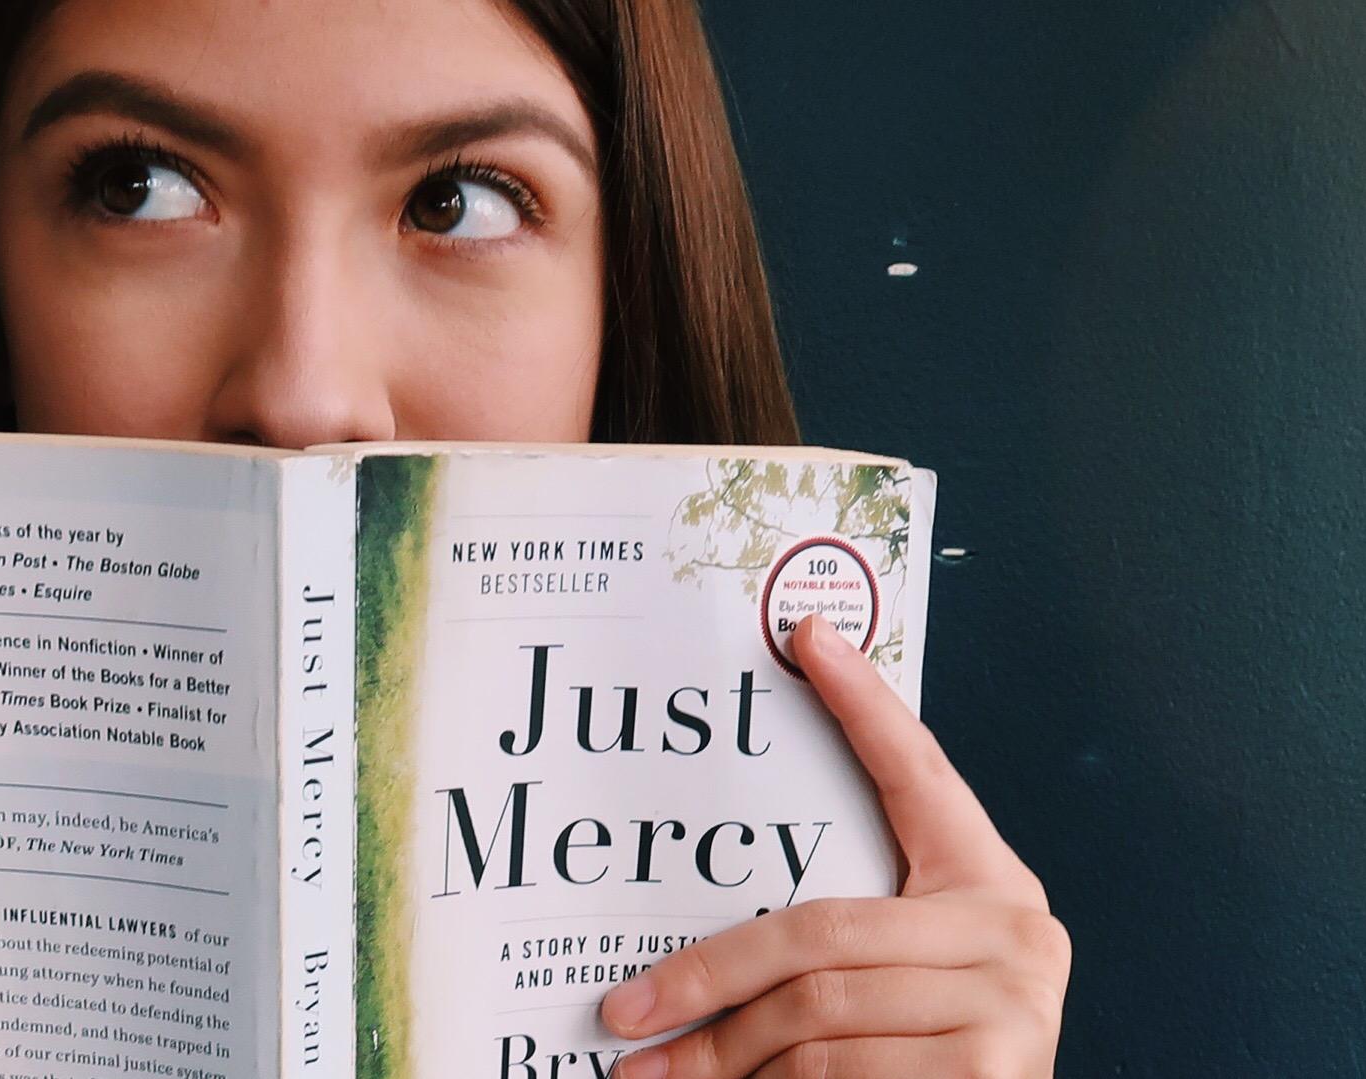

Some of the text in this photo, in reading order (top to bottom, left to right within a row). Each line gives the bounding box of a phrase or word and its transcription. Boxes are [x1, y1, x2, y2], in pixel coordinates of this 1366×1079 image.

[16, 523, 32, 539] of
[37, 524, 63, 541] the
[68, 529, 101, 545] year
[106, 528, 124, 547] by
[12, 551, 48, 569] Post
[66, 554, 95, 572] The
[99, 557, 153, 577] Boston
[157, 561, 200, 580] Globe
[452, 539, 645, 564] NEW YORK TIMES
[808, 559, 838, 575] 100
[33, 583, 93, 603] Esquire
[480, 573, 610, 596] BESTSELLER
[783, 581, 861, 590] NOTABLE BOOKS
[778, 617, 863, 632] Bo view
[37, 634, 52, 651] in
[57, 636, 137, 657] Nonfiction
[152, 643, 205, 664] Winner
[208, 650, 224, 666] of
[51, 664, 67, 681] of
[71, 666, 96, 683] the
[100, 668, 145, 687] Books
[148, 673, 169, 689] for
[172, 679, 182, 691] a
[186, 676, 231, 695] Better
[0, 689, 46, 708] Times
[49, 693, 88, 711] Book
[93, 696, 131, 715] Prize
[147, 701, 202, 723] Finalist
[206, 707, 227, 725] for
[498, 644, 772, 757] Just
[12, 720, 101, 741] Association
[106, 726, 165, 747] Notable
[169, 732, 206, 751] Book
[290, 583, 336, 892] Just Mercy
[11, 811, 51, 829] may,
[54, 810, 116, 833] indeed,
[119, 816, 139, 834] be
[26, 837, 57, 852] The
[59, 839, 96, 856] New
[99, 843, 135, 860] York
[138, 847, 184, 866] Times
[431, 780, 833, 918] Mercy
[3, 907, 103, 930] INFLUENTIAL
[108, 916, 177, 940] LAWYERS
[184, 929, 201, 943] of
[202, 933, 230, 946] our
[35, 937, 62, 954] the
[64, 942, 146, 967] redeeming
[147, 953, 214, 974] potential
[214, 961, 231, 975] of
[501, 934, 709, 962] A STORY OF JUST
[32, 967, 100, 987] attorney
[102, 973, 145, 991] when
[147, 977, 166, 993] he
[169, 980, 230, 1003] founded
[514, 966, 553, 990] AND
[31, 992, 107, 1012] dedicated
[111, 1000, 127, 1015] to
[129, 1002, 204, 1030] defending
[206, 1013, 230, 1030] the
[295, 946, 329, 1067] Bryan
[80, 1026, 110, 1041] and
[112, 1026, 154, 1046] those
[156, 1033, 213, 1057] trapped
[215, 1042, 230, 1059] in
[4, 1043, 23, 1059] of
[23, 1048, 53, 1061] our
[55, 1049, 121, 1068] criminal
[122, 1055, 174, 1076] justice
